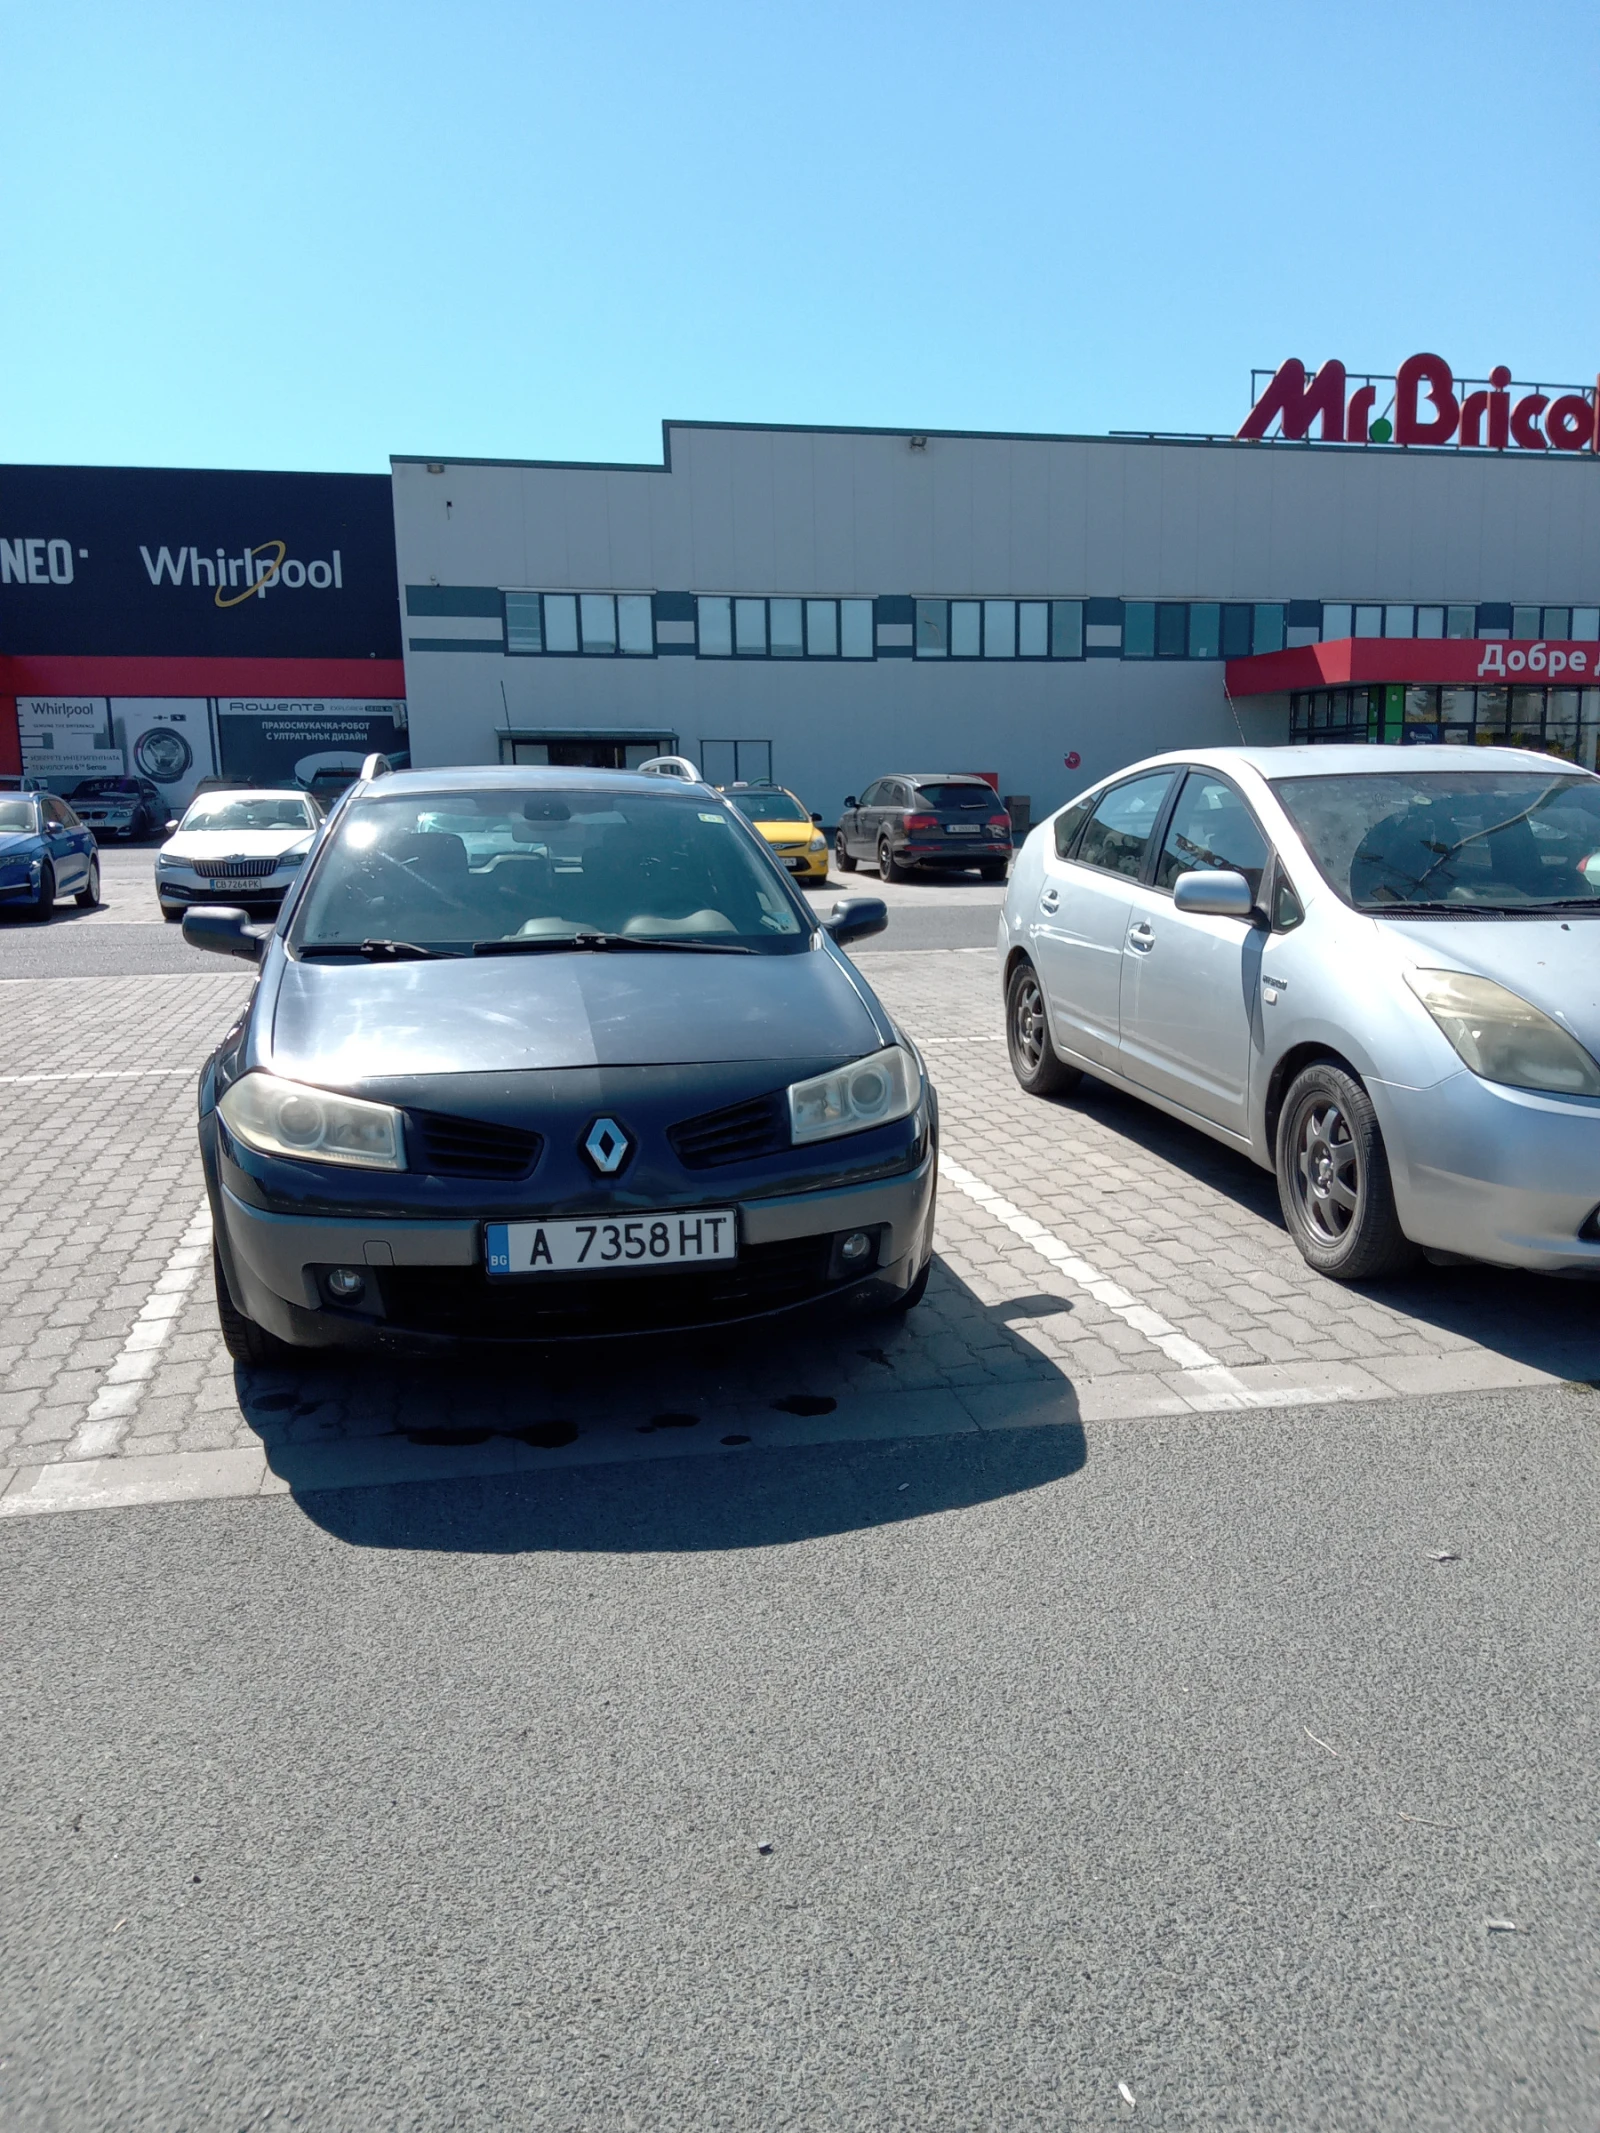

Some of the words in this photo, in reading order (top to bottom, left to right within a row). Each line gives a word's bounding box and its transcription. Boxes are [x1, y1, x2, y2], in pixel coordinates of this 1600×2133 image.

[139, 545, 343, 599] Whirlpool
[1478, 643, 1586, 677] Добре
[30, 702, 94, 719] Whirlpool
[229, 702, 325, 712] Rowenta
[261, 721, 370, 731] ПРАХОСМУКАЧКА-РОБОТ
[266, 732, 272, 741] С
[273, 732, 330, 741] УЛТРАТЪНЪК
[331, 731, 368, 742] ДИЗАЙН
[228, 880, 247, 889] 7264
[248, 880, 259, 888] PK
[529, 1228, 553, 1266] A
[575, 1222, 670, 1263] 7358
[679, 1217, 727, 1256] HT
[490, 1254, 508, 1267] BG
